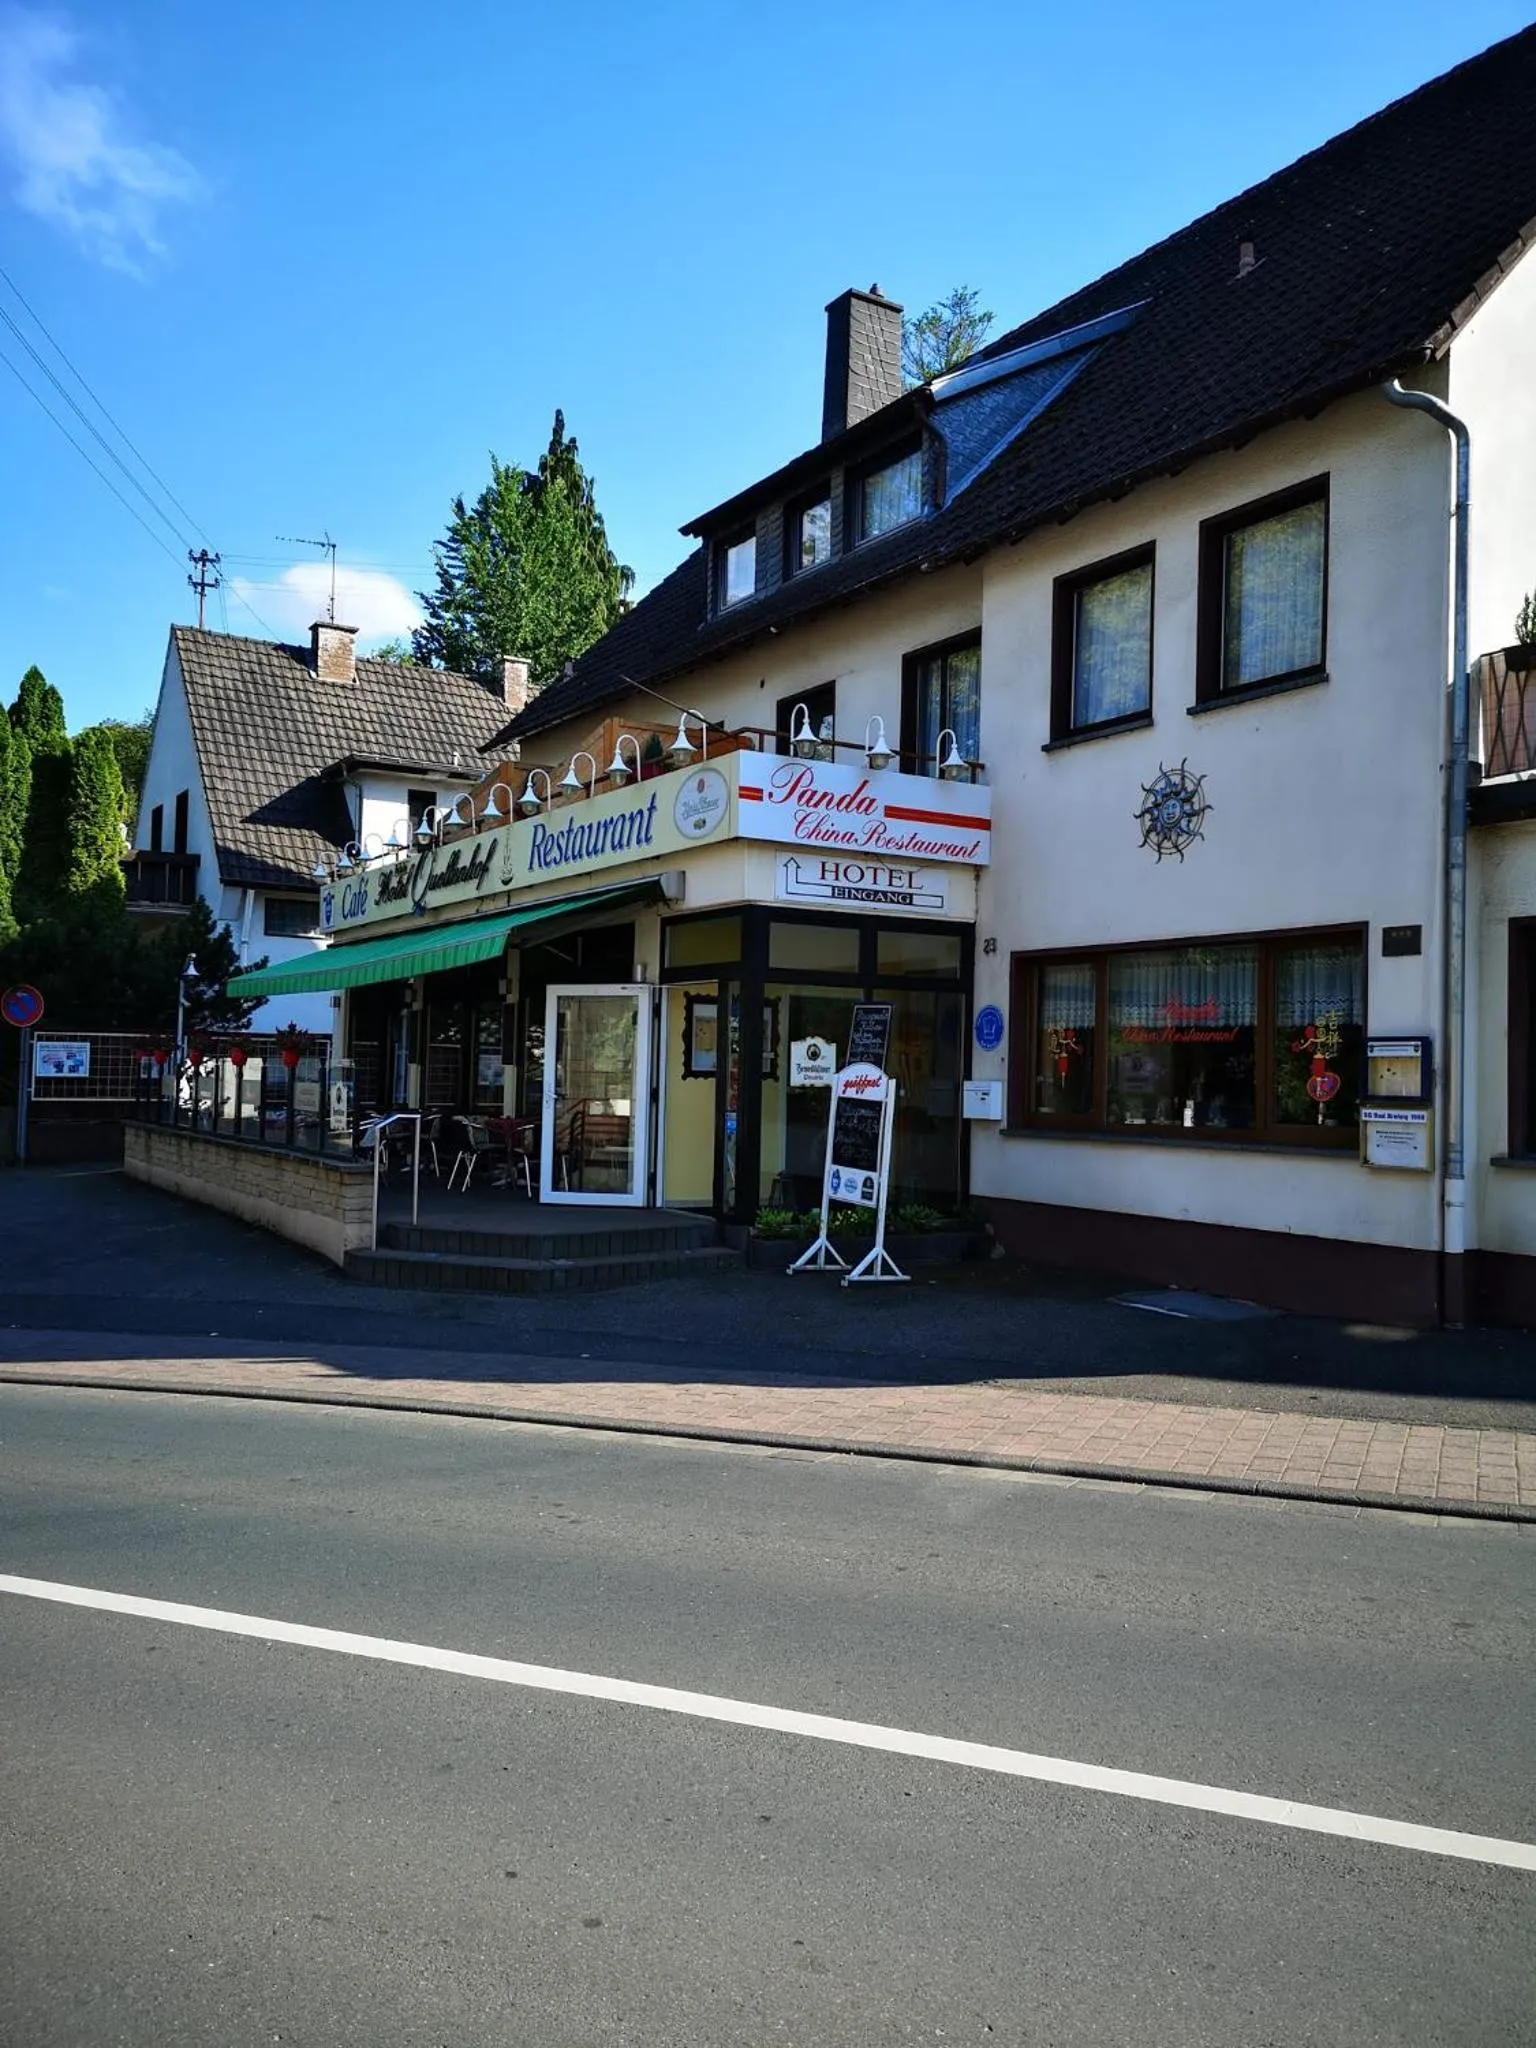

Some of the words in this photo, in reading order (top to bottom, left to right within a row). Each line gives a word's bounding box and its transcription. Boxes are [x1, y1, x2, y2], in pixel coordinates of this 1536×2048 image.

[768, 762, 878, 816] Panda
[527, 792, 658, 872] Restaurant
[794, 809, 855, 846] China
[854, 820, 981, 859] Restaurant
[819, 859, 924, 891] HOTEL
[833, 887, 913, 906] EINGANG
[341, 876, 369, 921] Café
[842, 1073, 881, 1095] geöffnet
